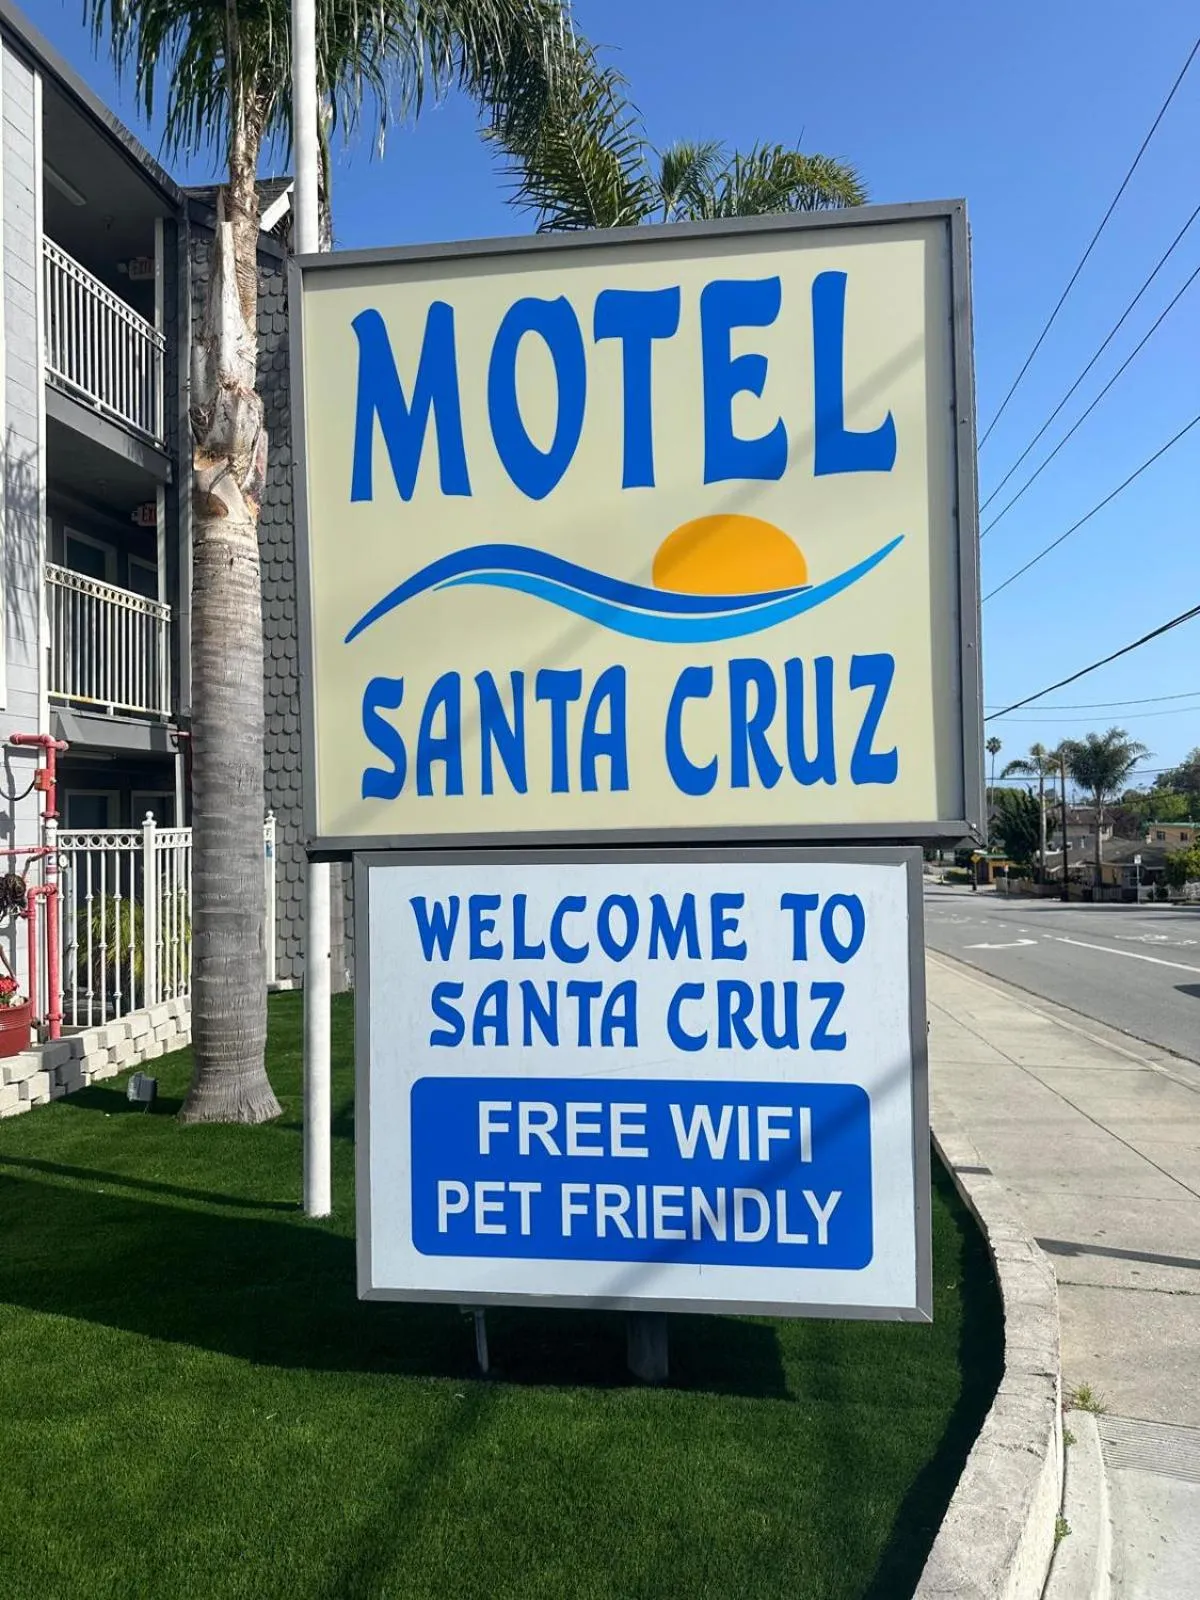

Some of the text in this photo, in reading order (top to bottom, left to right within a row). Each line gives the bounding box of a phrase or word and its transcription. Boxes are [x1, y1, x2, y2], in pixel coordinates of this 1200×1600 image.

[351, 271, 897, 501] MOTEL
[362, 653, 898, 799] SANTA CRUZ
[409, 891, 865, 964] WELCOME TO
[428, 979, 847, 1053] SANTA CRUZ
[478, 1101, 812, 1162] FREE WIFI
[438, 1180, 842, 1245] PET FRIENDLY
